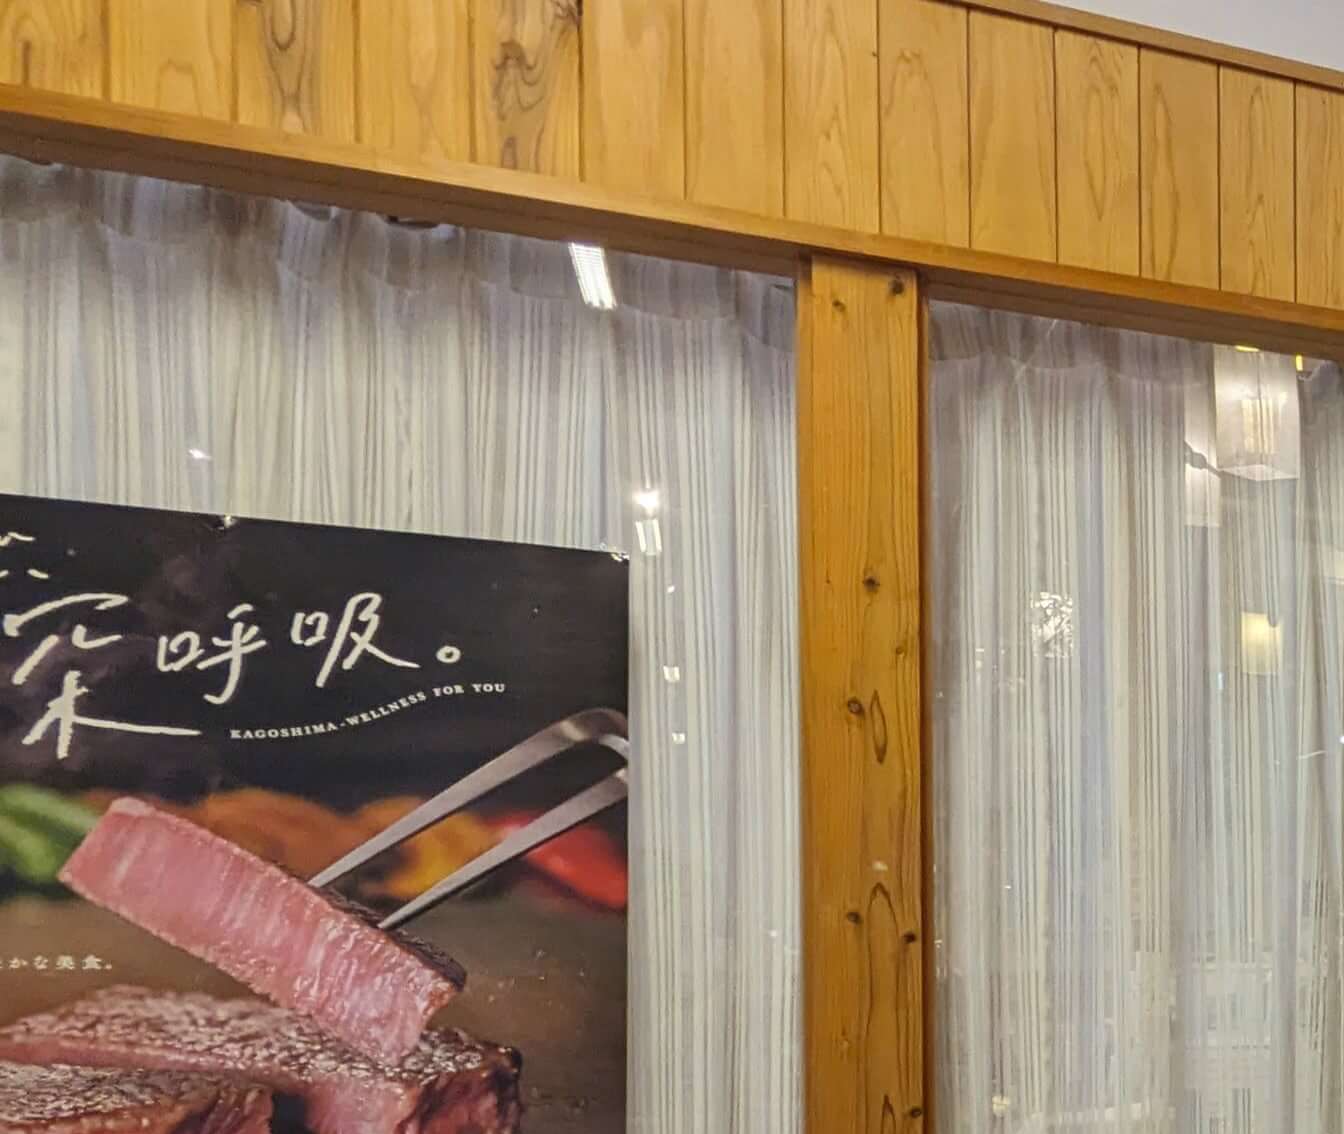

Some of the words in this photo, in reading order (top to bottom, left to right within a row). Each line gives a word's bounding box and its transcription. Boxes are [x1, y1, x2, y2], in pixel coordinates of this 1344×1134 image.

[230, 691, 427, 740] KAGOSHIMA-WELLNESS
[432, 684, 465, 697] FOR
[472, 682, 506, 693] YOU
